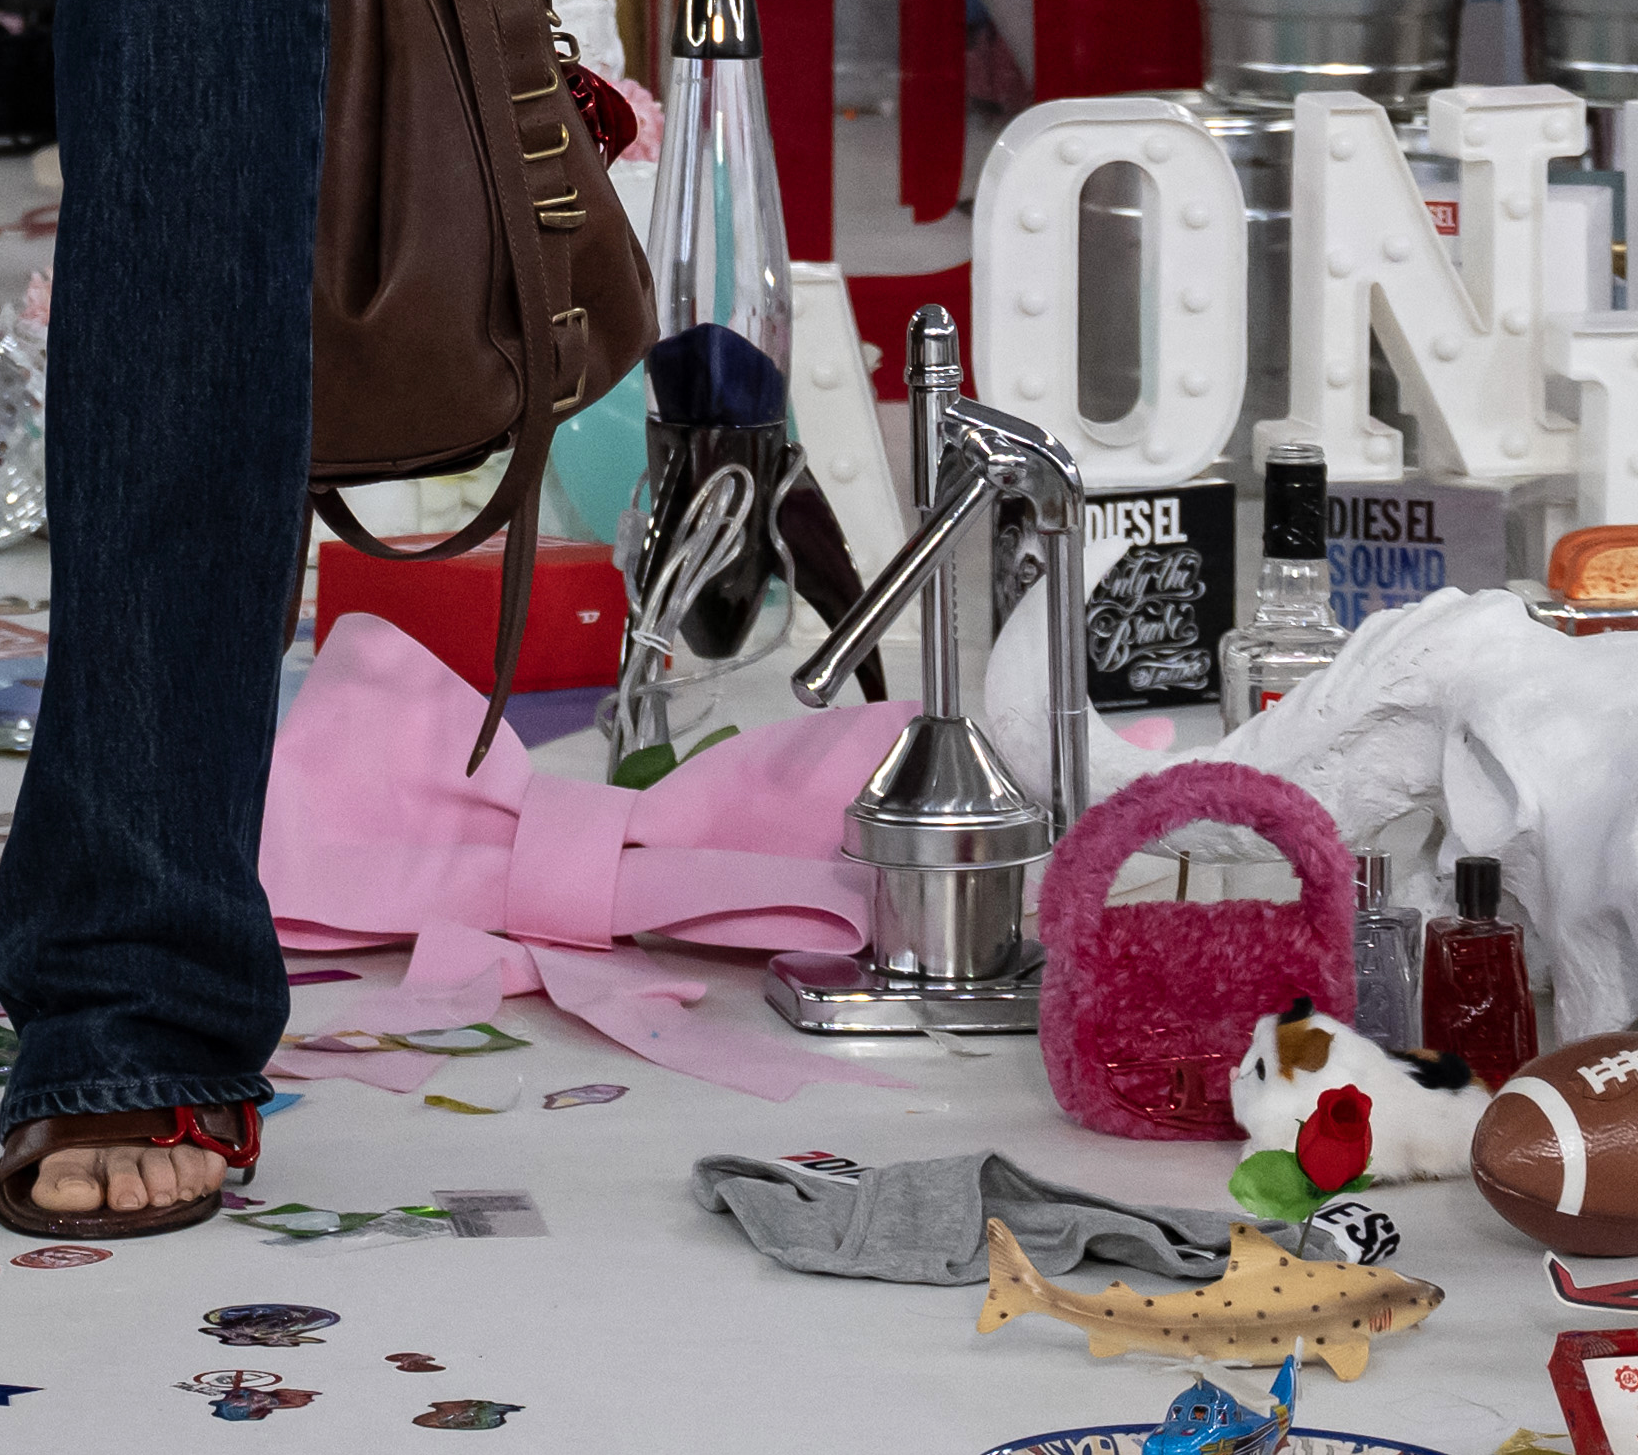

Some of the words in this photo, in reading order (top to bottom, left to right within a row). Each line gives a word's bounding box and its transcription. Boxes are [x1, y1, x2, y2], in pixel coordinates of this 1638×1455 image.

[1086, 498, 1188, 546] DIESEL
[1328, 496, 1444, 545] DIESEL
[1328, 544, 1446, 591] SOUND
